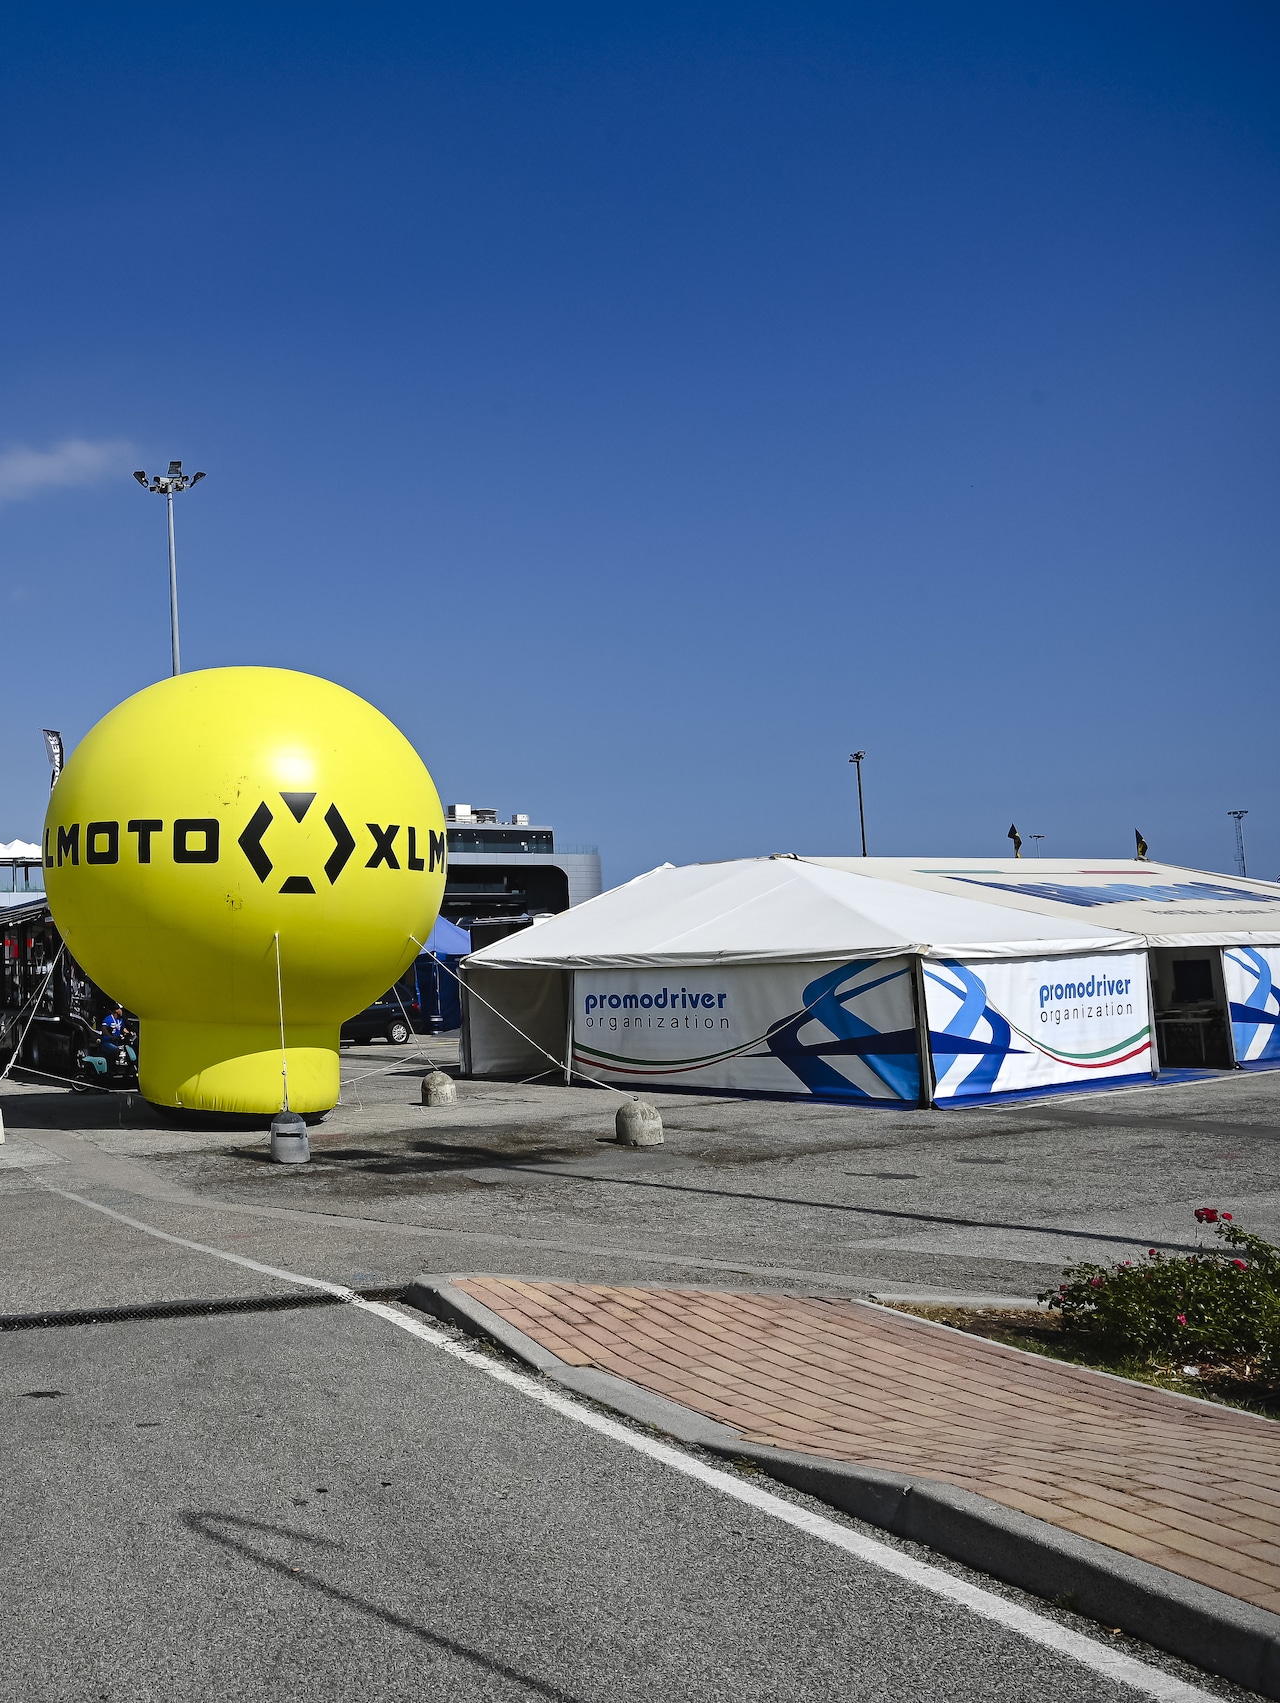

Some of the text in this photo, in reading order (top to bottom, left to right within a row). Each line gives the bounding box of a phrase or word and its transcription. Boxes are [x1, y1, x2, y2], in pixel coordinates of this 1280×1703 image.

[365, 822, 447, 873] XLM
[585, 987, 727, 1015] promodriver
[1039, 974, 1131, 1009] promodriver
[585, 1013, 730, 1031] organization
[1039, 1001, 1134, 1026] organization
